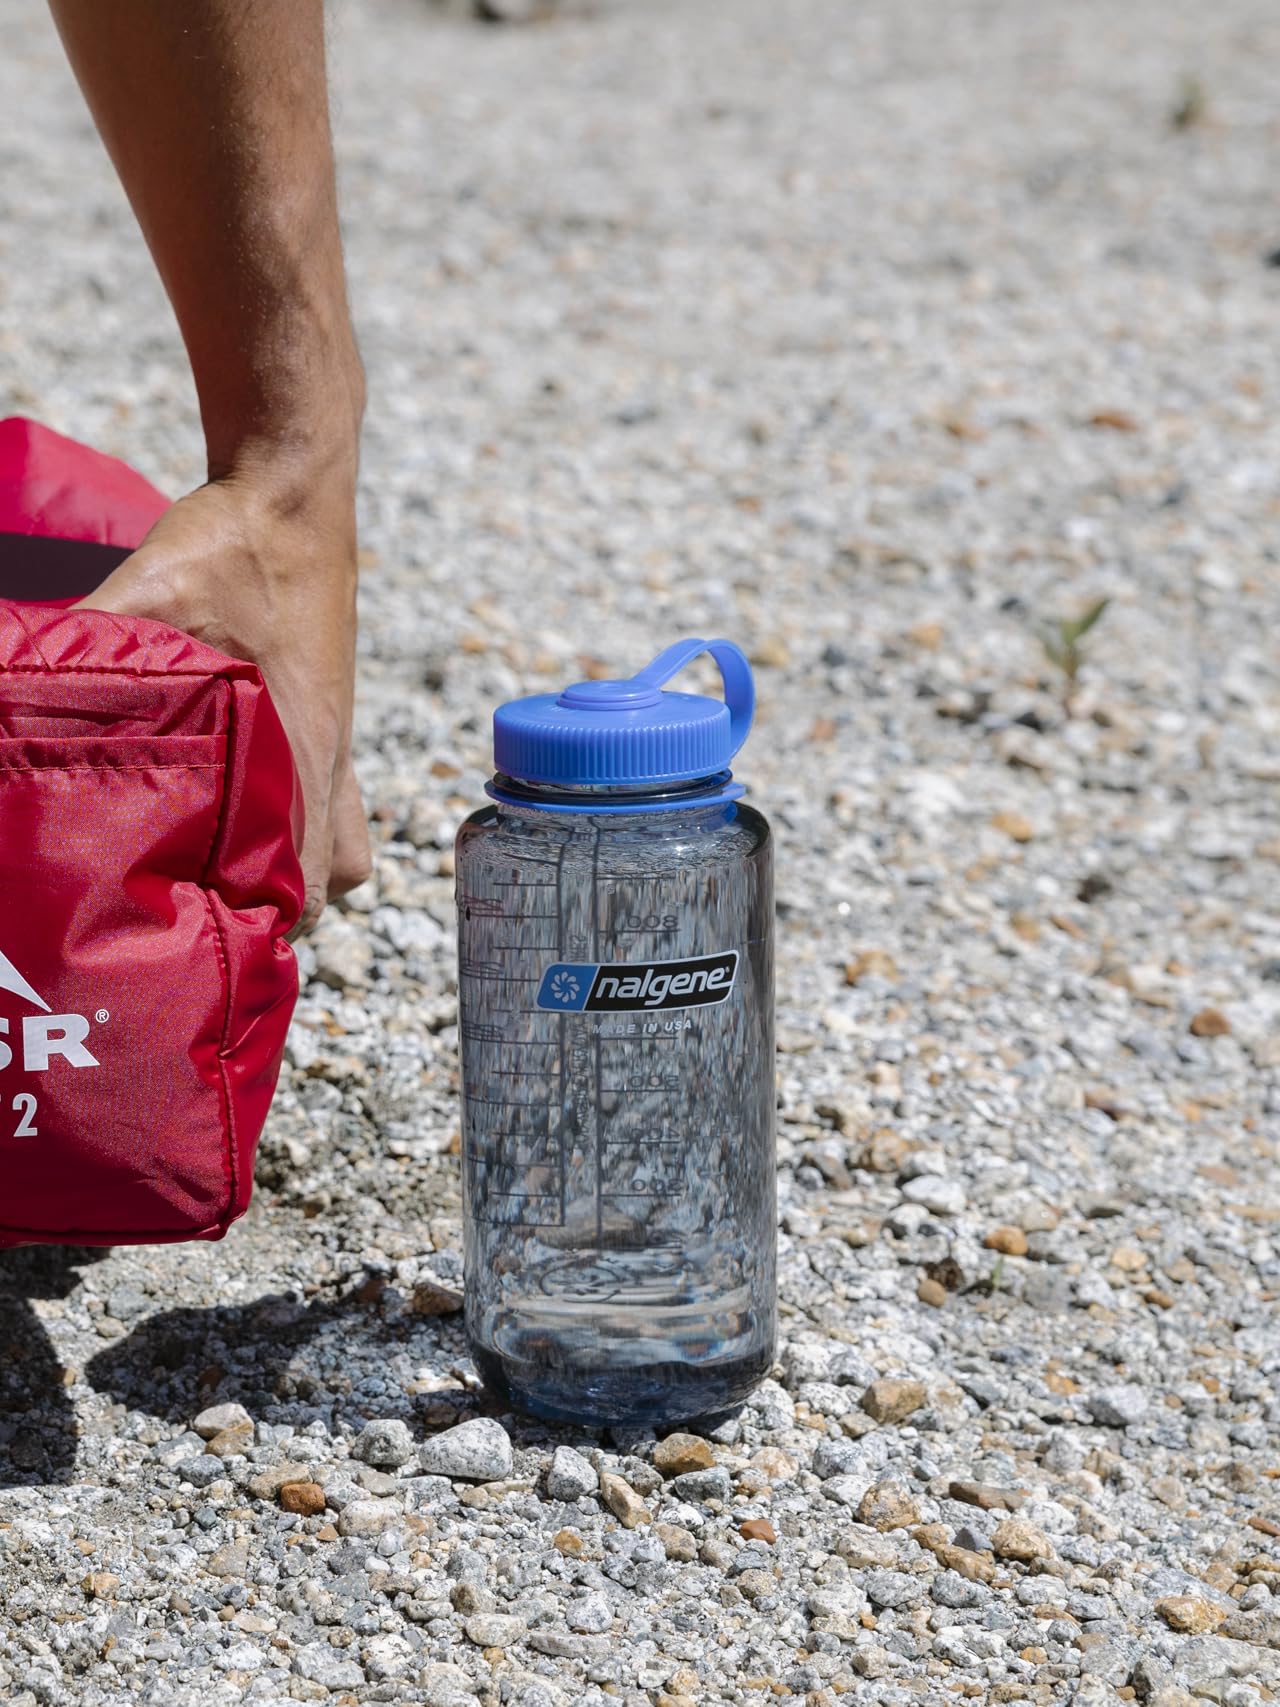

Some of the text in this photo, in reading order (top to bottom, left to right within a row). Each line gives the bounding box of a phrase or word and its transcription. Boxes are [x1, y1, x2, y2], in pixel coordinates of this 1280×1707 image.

[592, 1019, 693, 1034] MADE IN USA
[12, 1092, 39, 1137] 2
